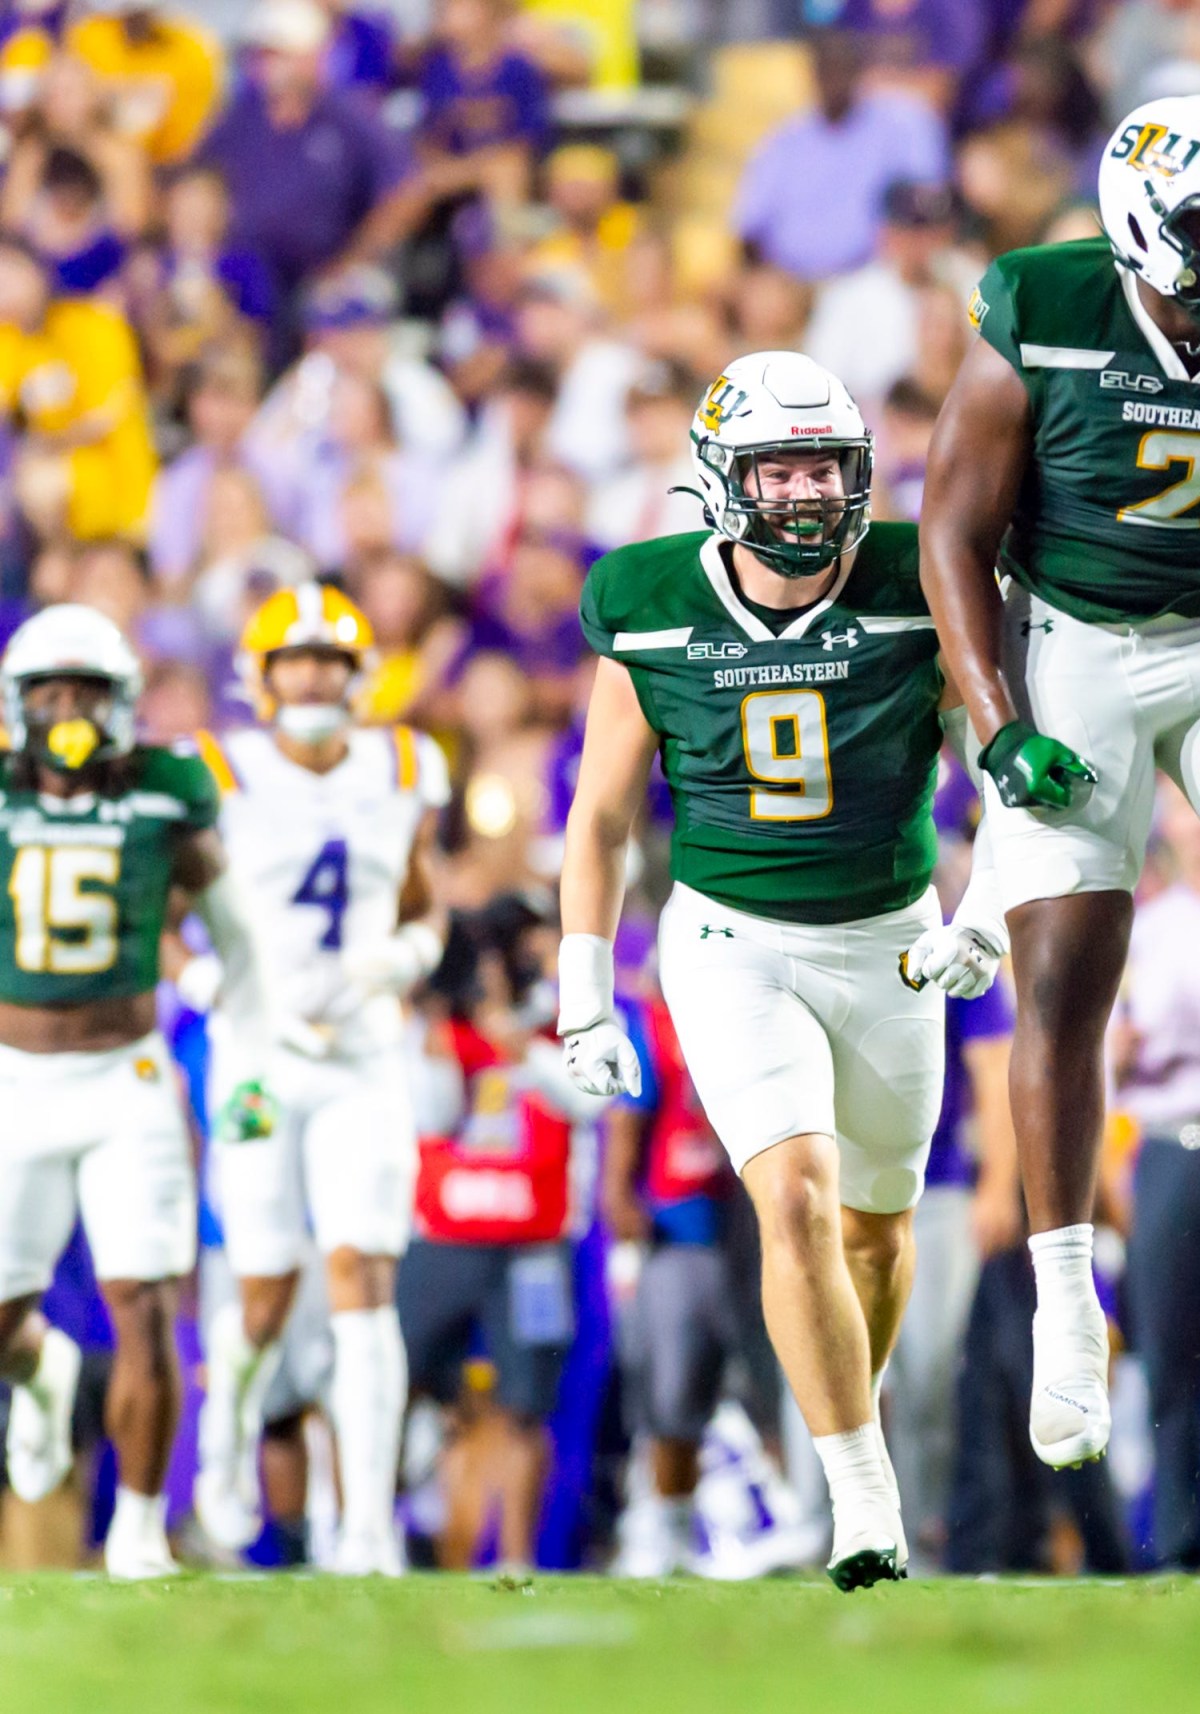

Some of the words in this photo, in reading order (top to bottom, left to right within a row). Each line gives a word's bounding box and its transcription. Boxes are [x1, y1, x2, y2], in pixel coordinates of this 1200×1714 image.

[713, 661, 850, 688] SOUTHEASTERN
[740, 688, 834, 822] 9
[7, 845, 121, 974] 15
[292, 837, 348, 950] 4
